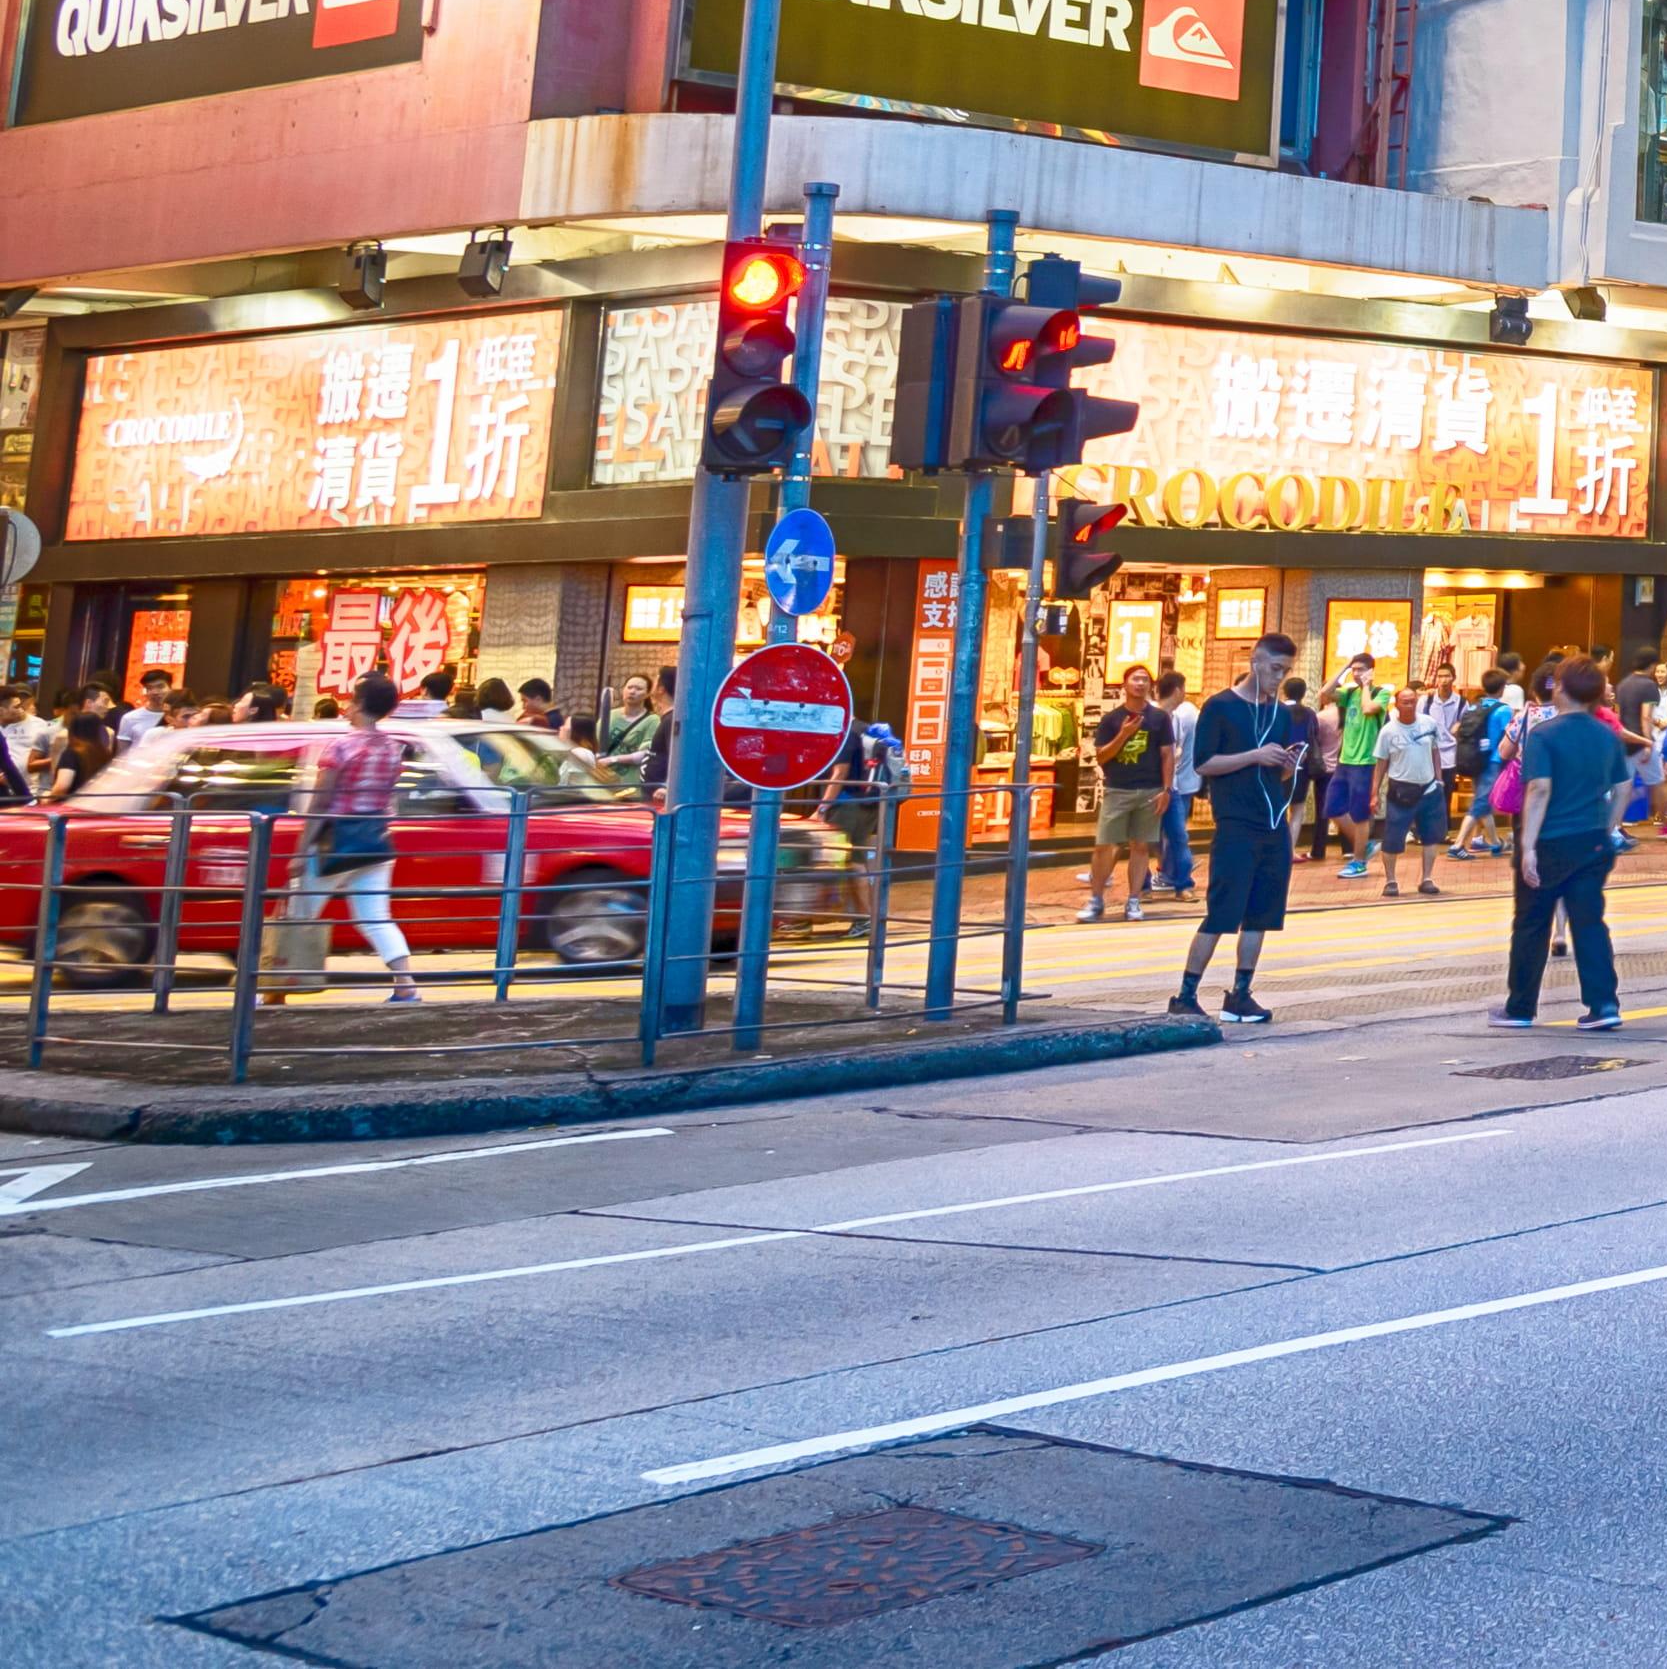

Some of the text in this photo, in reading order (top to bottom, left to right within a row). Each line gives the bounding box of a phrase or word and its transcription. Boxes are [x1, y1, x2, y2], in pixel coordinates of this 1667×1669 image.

[109, 409, 234, 448] CROCODILE
[316, 341, 415, 424] 搬遷
[409, 339, 461, 505] 1
[1211, 351, 1493, 454] 搬遷清貨
[308, 433, 404, 511] 清貨
[464, 393, 530, 500] 折
[1518, 383, 1568, 514] 1
[1577, 433, 1636, 516] 折
[1055, 463, 1468, 532] CROCODILE
[317, 588, 450, 696] 最後
